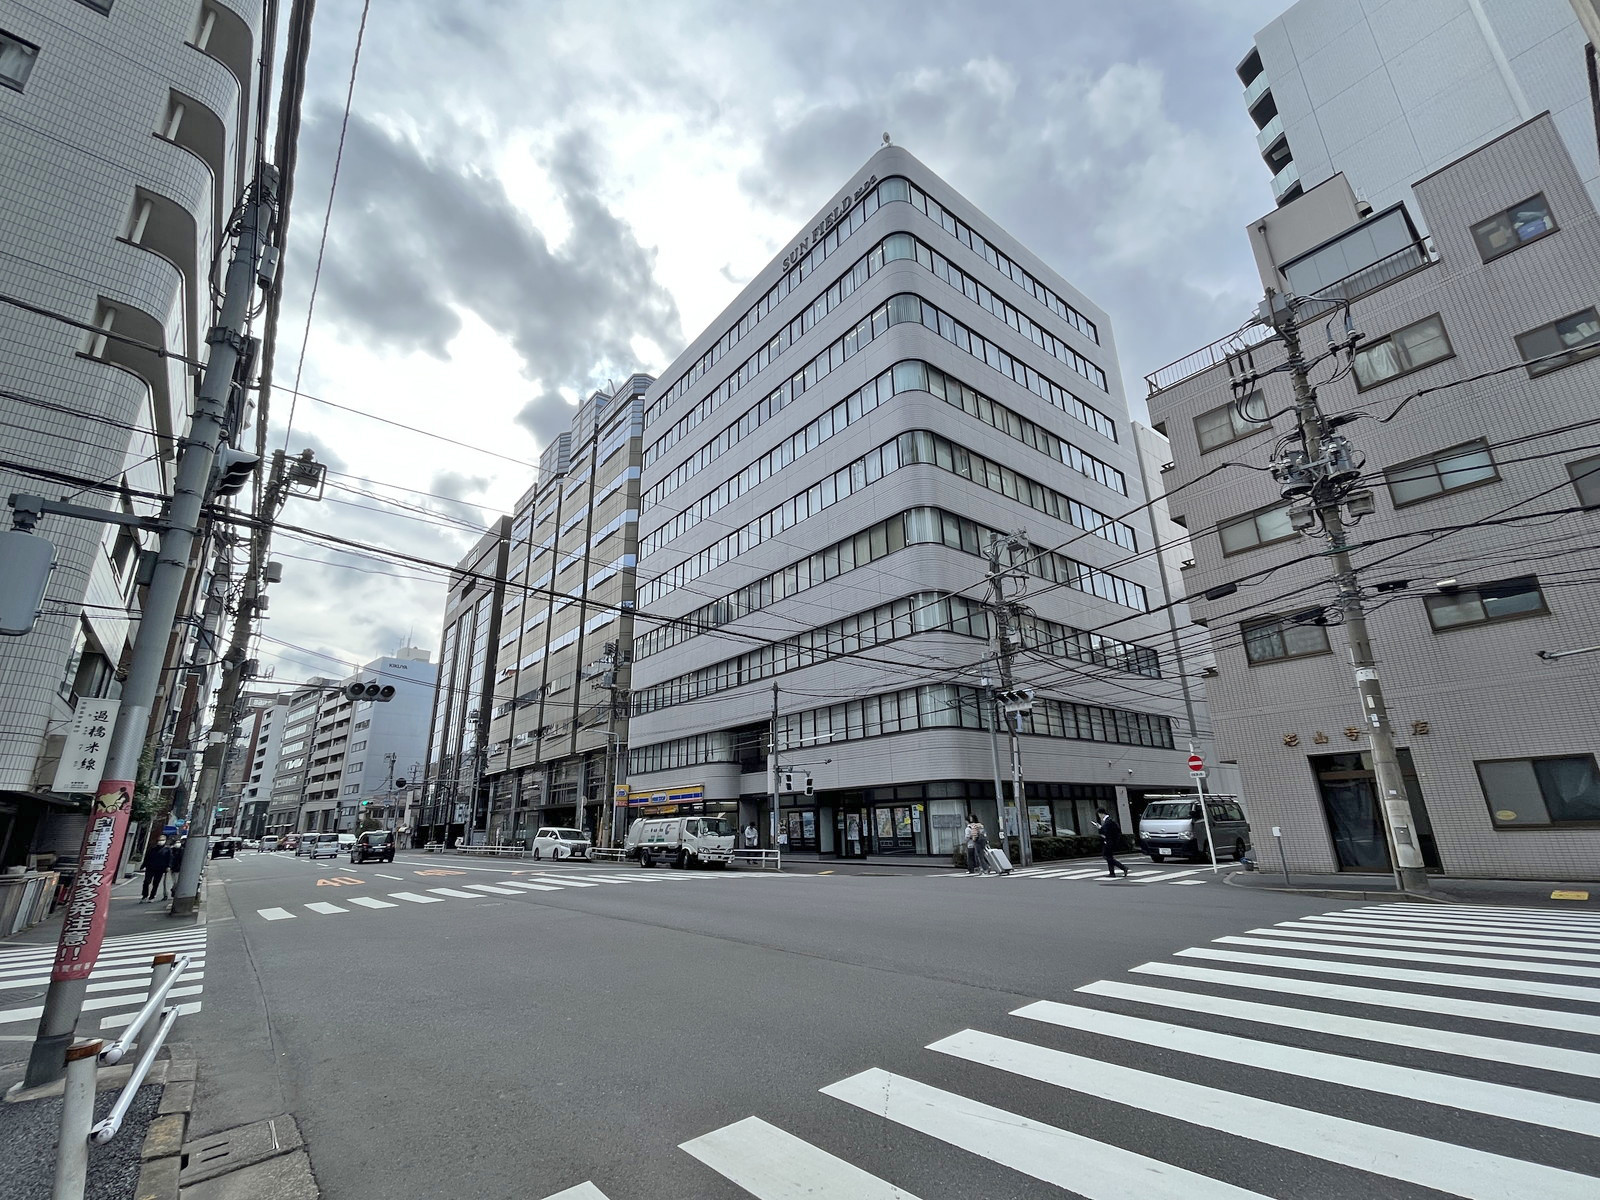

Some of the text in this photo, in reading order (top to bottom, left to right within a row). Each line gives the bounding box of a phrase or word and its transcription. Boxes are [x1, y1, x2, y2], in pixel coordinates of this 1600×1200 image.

[782, 237, 809, 272] SUN
[811, 195, 853, 244] FIELD
[79, 710, 110, 771] 過橋米線
[316, 876, 366, 887] 40
